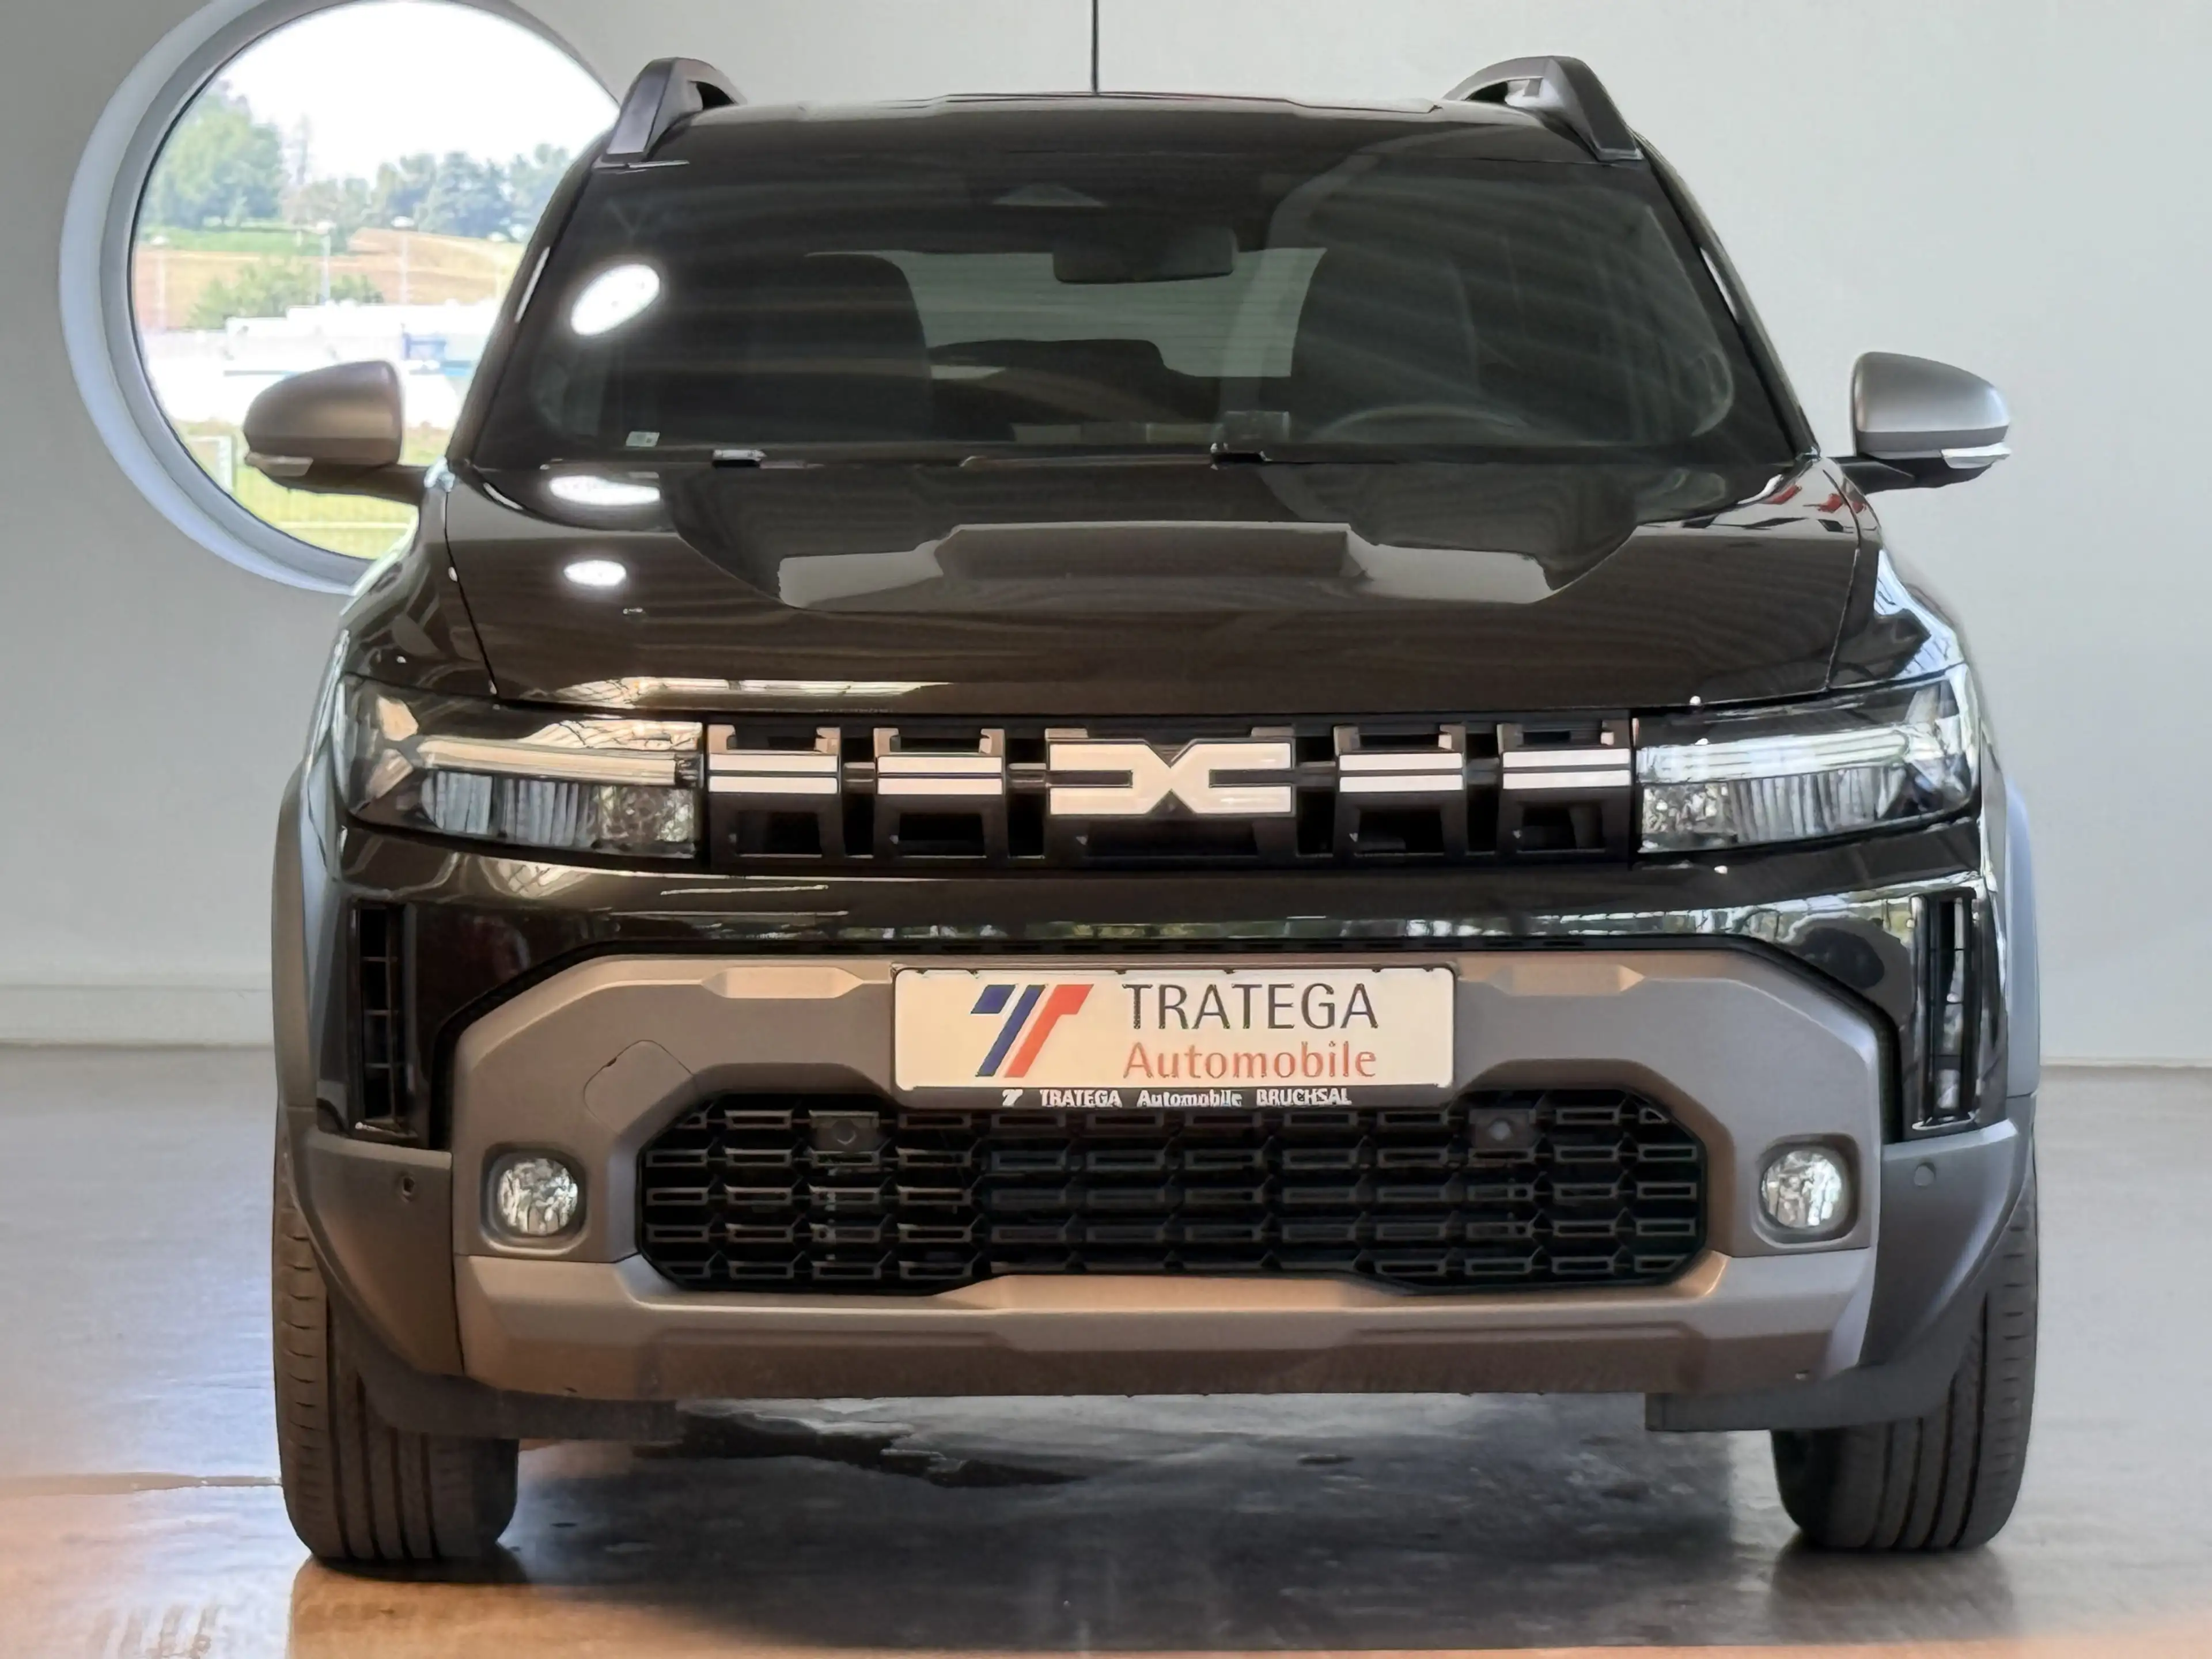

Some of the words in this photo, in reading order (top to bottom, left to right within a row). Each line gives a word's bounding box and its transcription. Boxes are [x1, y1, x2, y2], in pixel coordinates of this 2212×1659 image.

[1122, 983, 1378, 1029] TRATEGA
[1123, 1040, 1376, 1079] Automobile
[1039, 1089, 1123, 1108] TRATEGA
[1136, 1089, 1243, 1108] Automobile
[1256, 1088, 1353, 1106] BRUCHSAL
